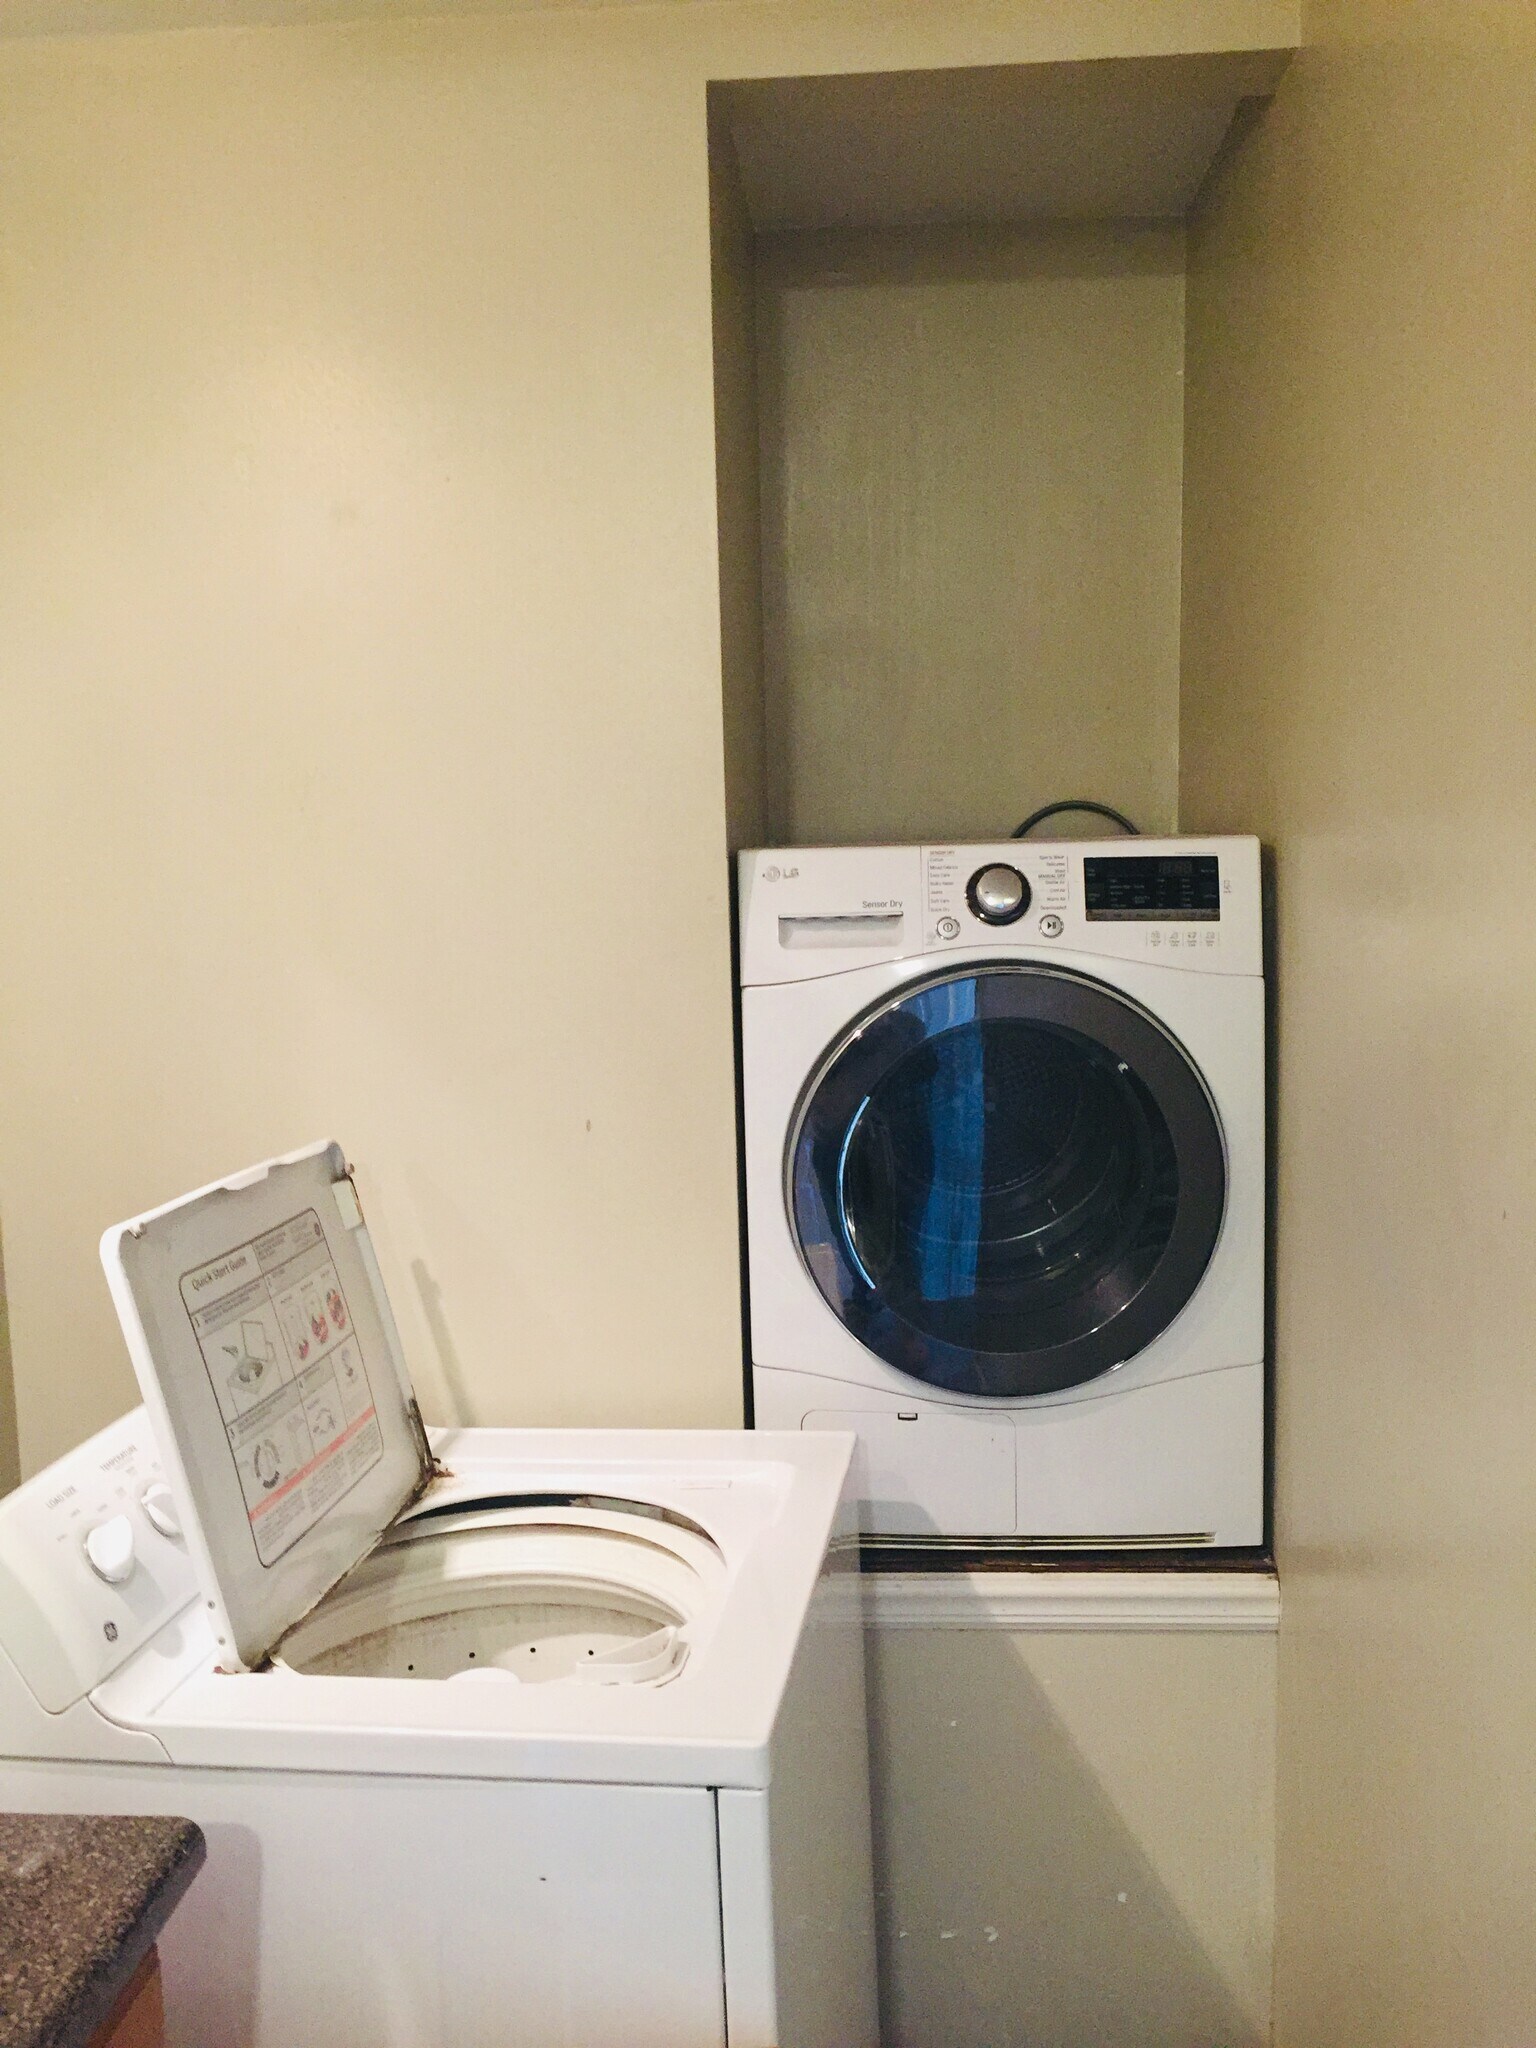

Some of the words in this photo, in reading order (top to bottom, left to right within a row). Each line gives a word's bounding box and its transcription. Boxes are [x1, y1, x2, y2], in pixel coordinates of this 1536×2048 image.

[862, 900, 888, 909] Sensor
[889, 899, 904, 908] Dry
[191, 1271, 213, 1291] Quick
[212, 1264, 230, 1280] Start
[228, 1256, 247, 1272] Guide
